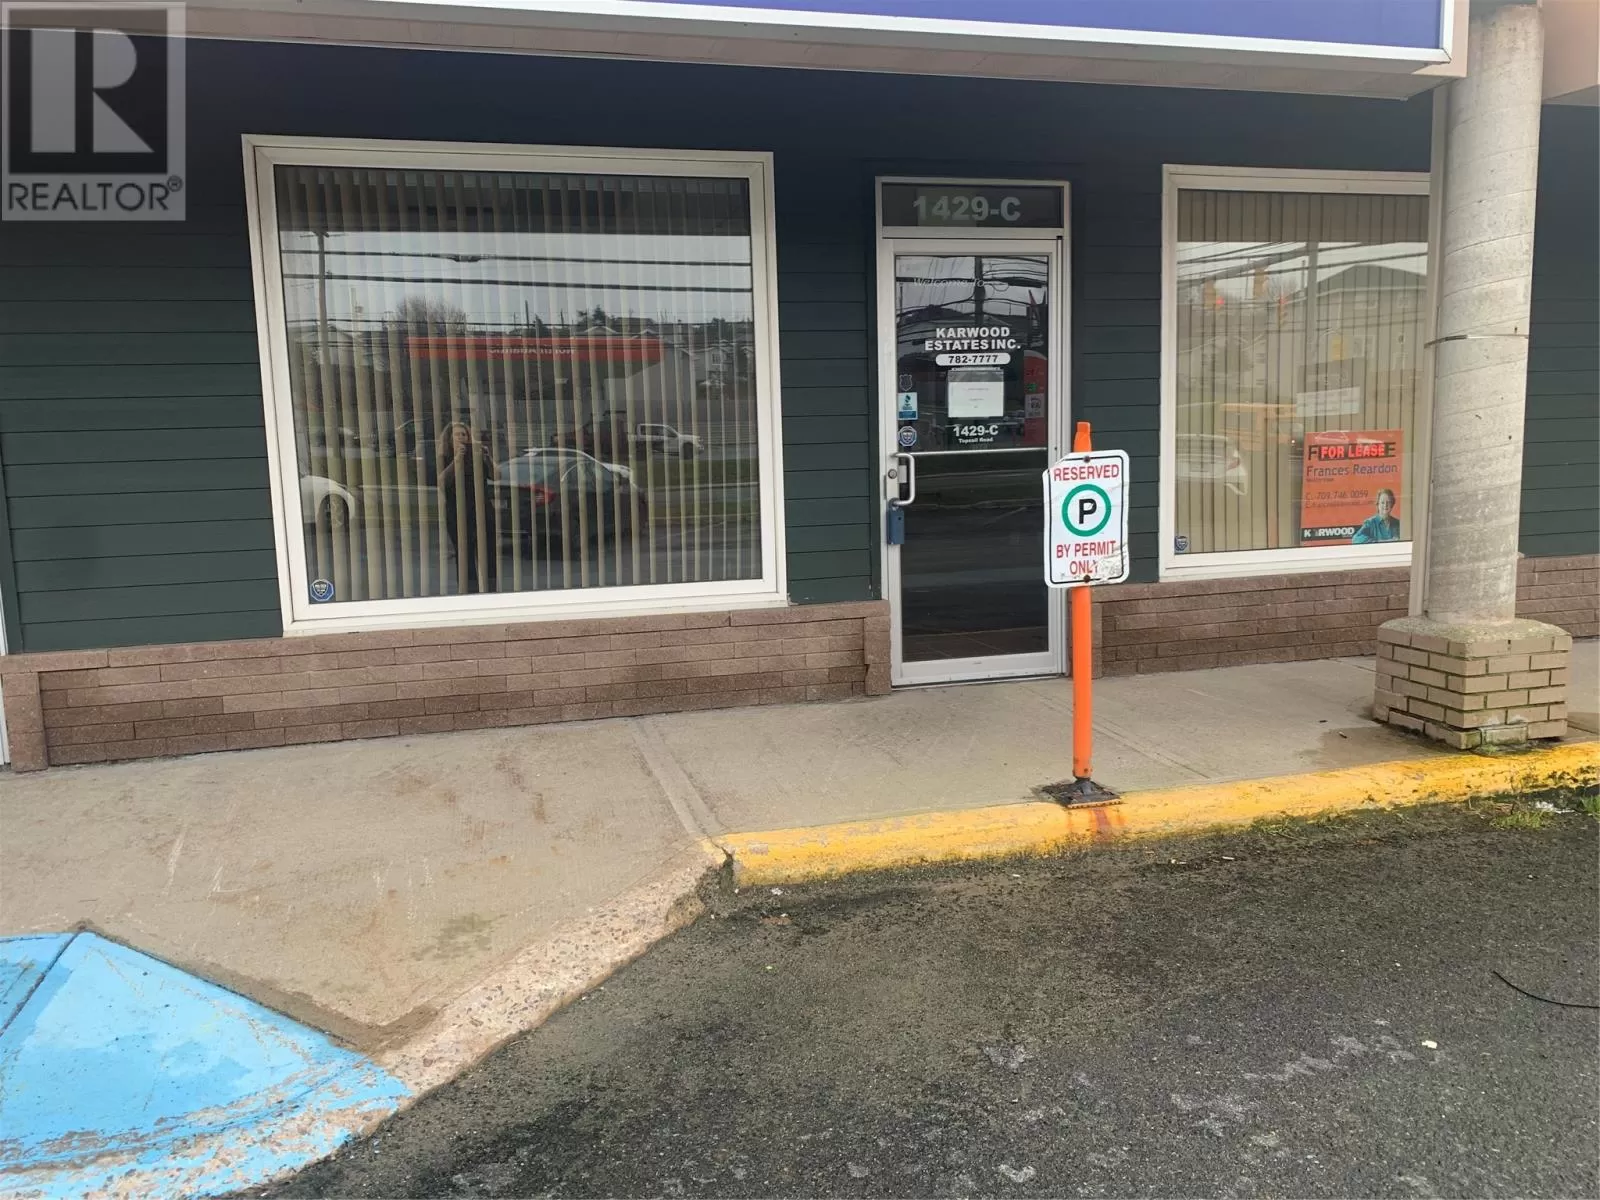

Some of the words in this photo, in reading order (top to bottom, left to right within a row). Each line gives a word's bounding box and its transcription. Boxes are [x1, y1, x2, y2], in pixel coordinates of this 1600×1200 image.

[913, 195, 1021, 221] 1429-C
[936, 327, 1010, 338] KARWOOD
[924, 340, 989, 351] ESTATES
[991, 339, 1021, 350] INC.
[948, 354, 999, 364] 782-7777
[953, 425, 999, 437] 1429-C
[1320, 445, 1345, 459] FOR
[1348, 444, 1386, 458] LEASE
[1053, 464, 1120, 481] RESERVED
[1306, 465, 1349, 477] Frances
[1353, 463, 1398, 475] Reardon
[1078, 498, 1097, 524] P
[1056, 544, 1071, 558] BY
[1074, 540, 1116, 557] PERMIT
[1069, 559, 1099, 575] ONLY
